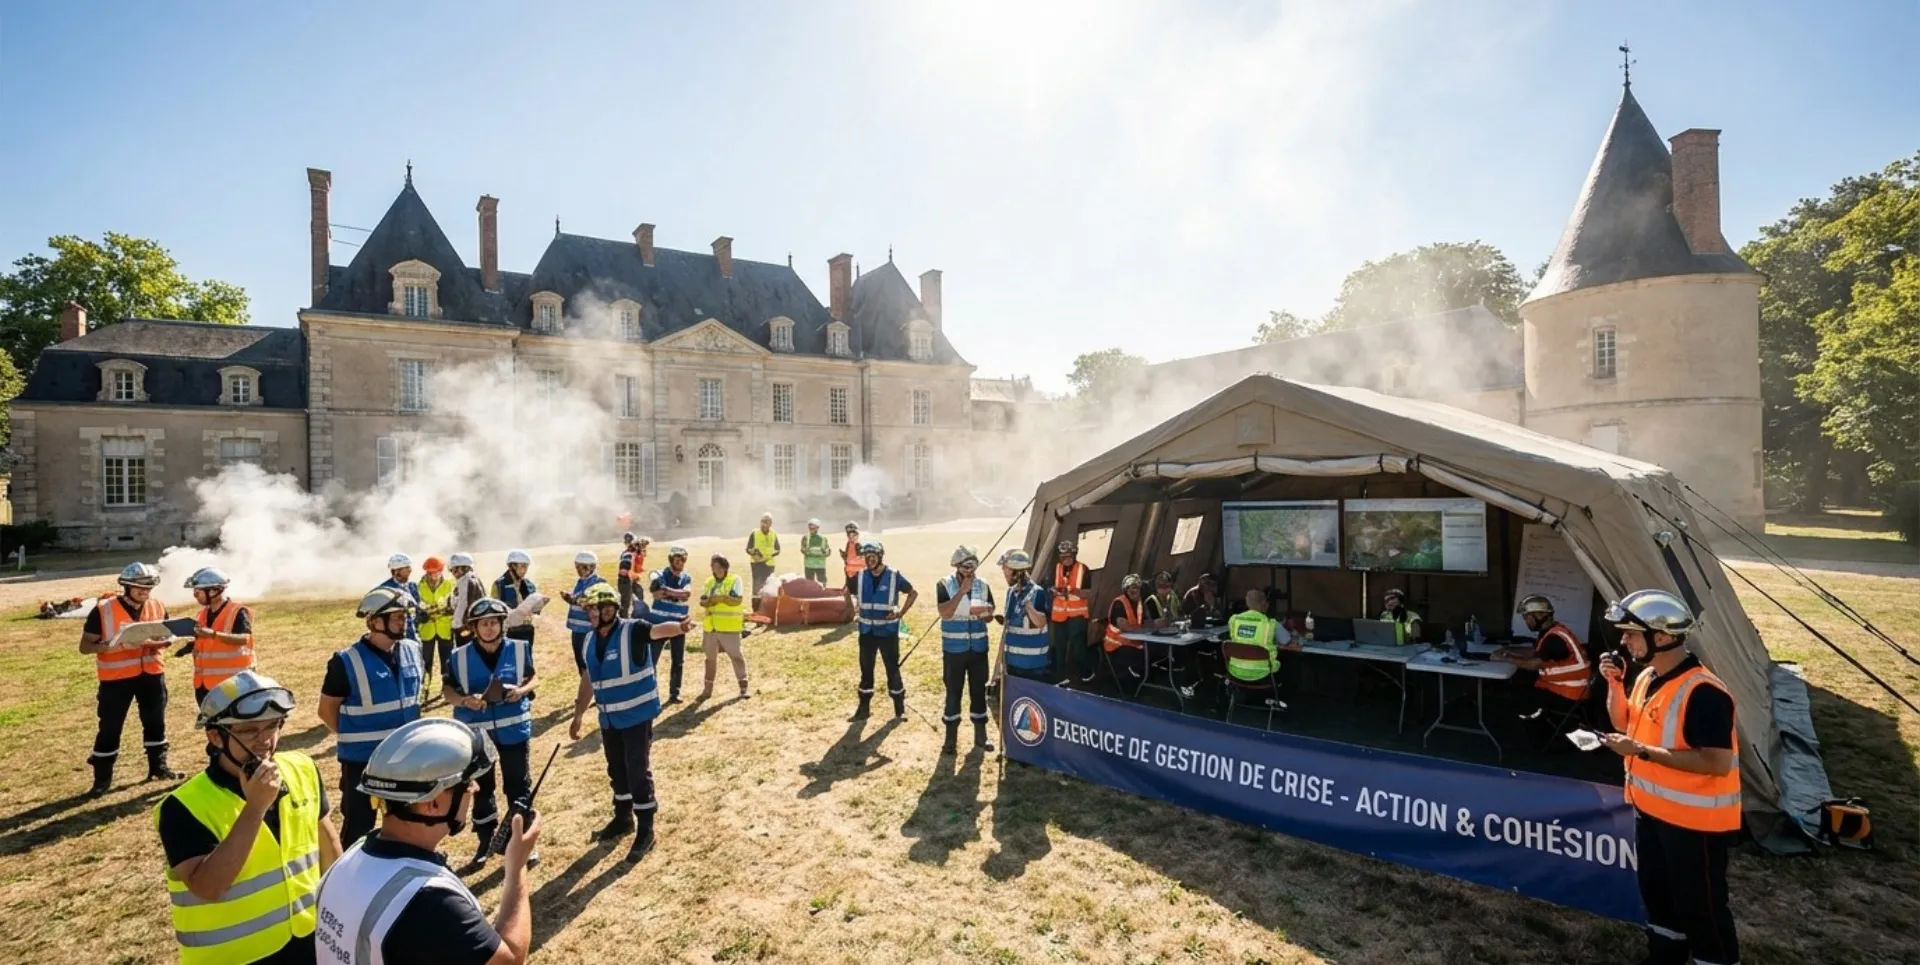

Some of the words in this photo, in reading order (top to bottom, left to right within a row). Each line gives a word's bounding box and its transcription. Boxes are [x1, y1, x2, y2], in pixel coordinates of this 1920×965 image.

[1053, 717, 1124, 756] EXERCICE
[1128, 737, 1151, 763] DE
[1155, 743, 1234, 782] GESTION
[1239, 760, 1265, 790] DE
[1270, 767, 1335, 806] CRISE
[1355, 787, 1447, 832] ACTION
[1456, 807, 1476, 837] &
[1483, 812, 1638, 872] COHÉSION
